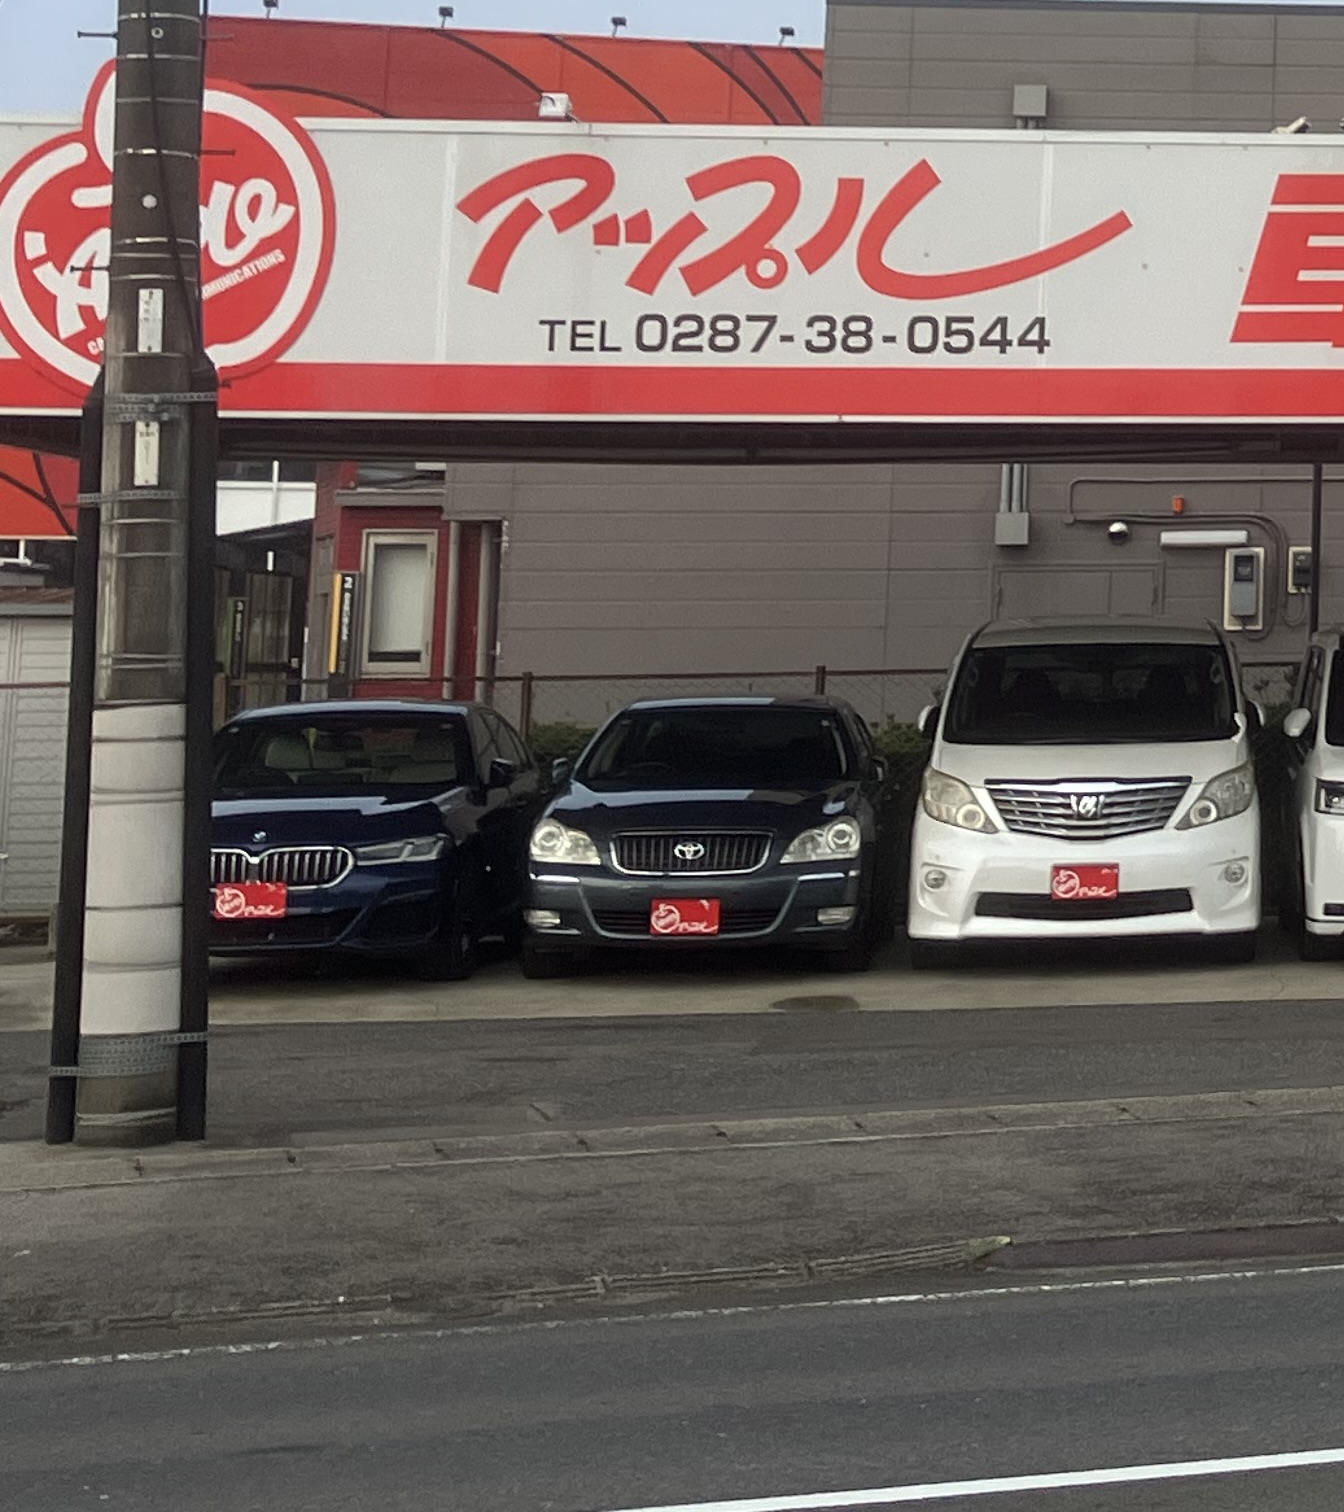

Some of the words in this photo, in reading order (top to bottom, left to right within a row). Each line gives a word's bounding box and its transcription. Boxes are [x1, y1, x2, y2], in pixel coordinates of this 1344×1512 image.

[456, 152, 1134, 301] アップル
[538, 318, 622, 353] TEL
[633, 313, 1052, 356] 0287-38-0544
